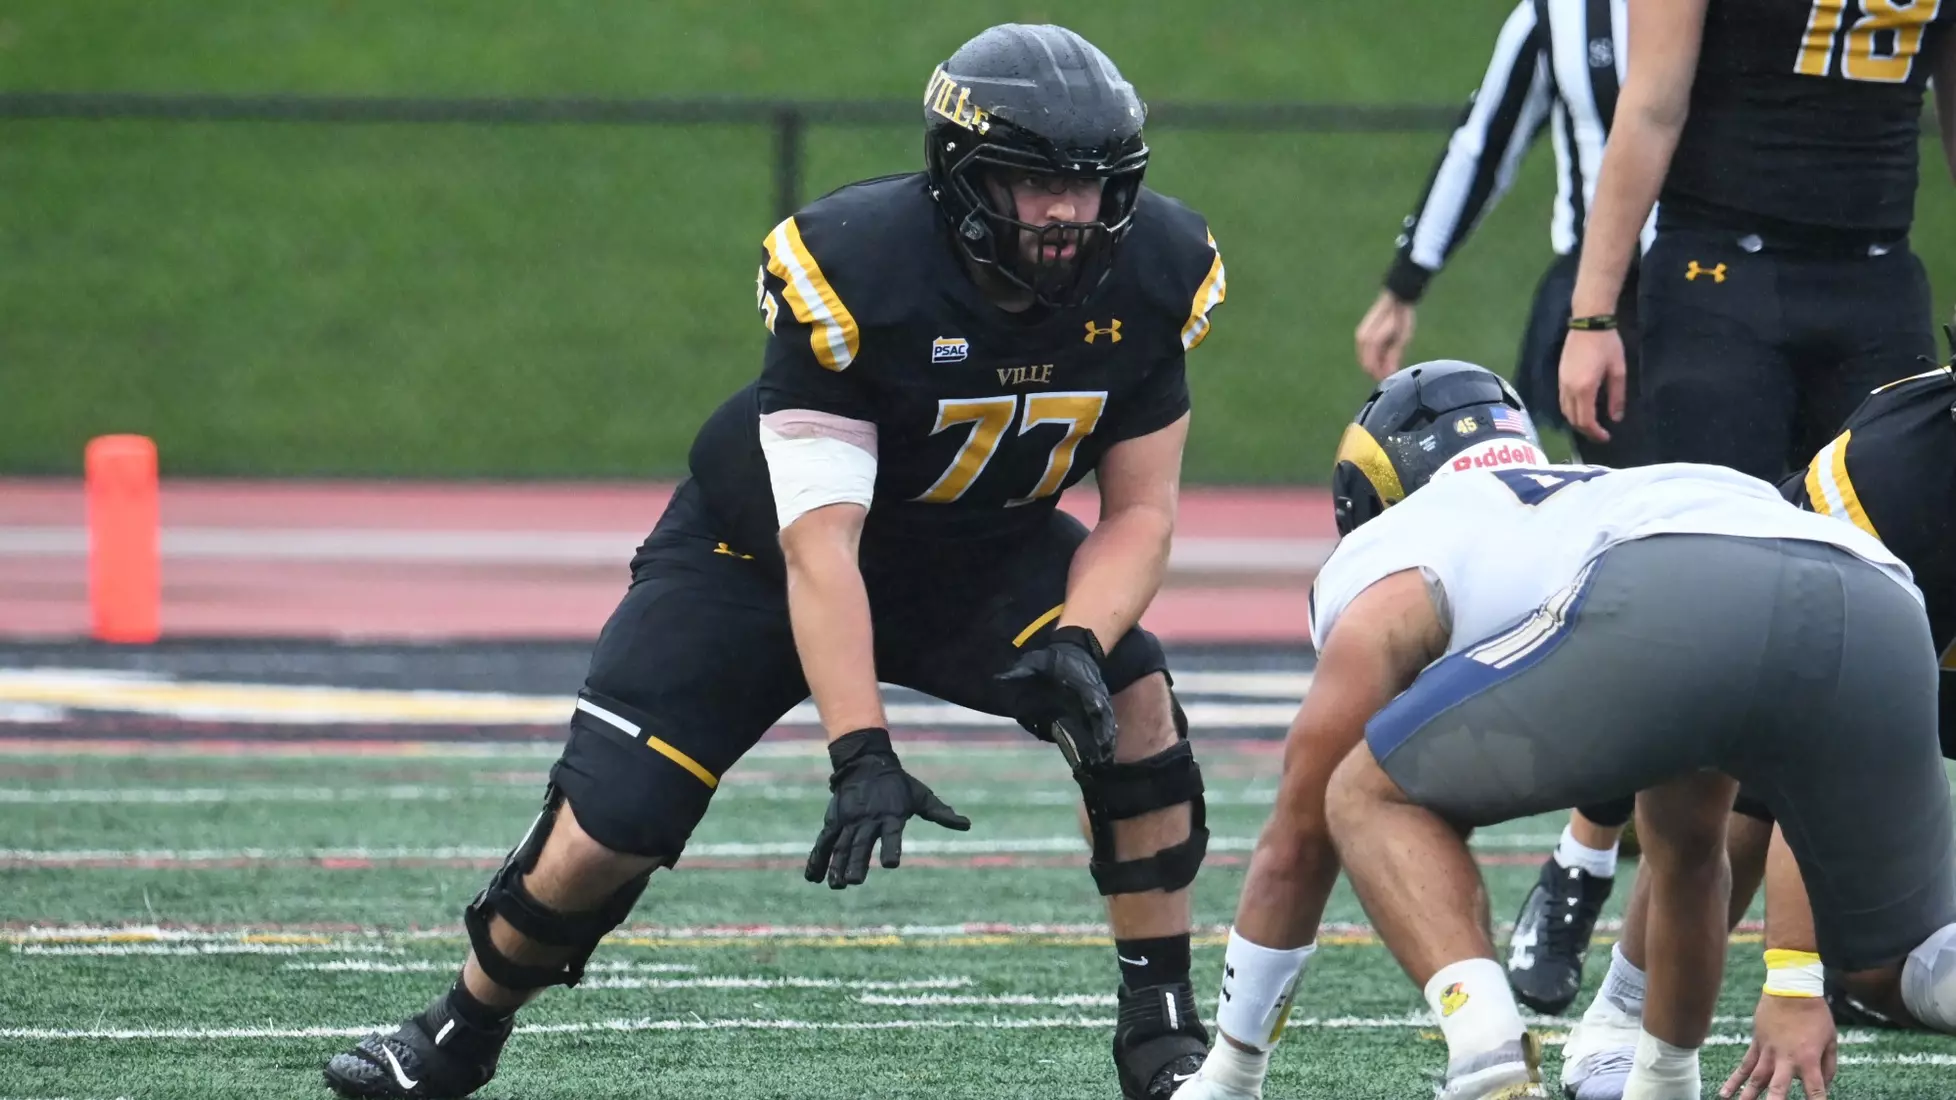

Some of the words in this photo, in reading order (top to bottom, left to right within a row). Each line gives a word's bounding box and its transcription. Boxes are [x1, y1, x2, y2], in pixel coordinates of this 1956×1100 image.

[934, 345, 966, 356] PSAC
[997, 364, 1054, 387] VILLE
[1456, 416, 1478, 434] 45
[906, 391, 1109, 508] 77
[1452, 445, 1537, 472] Riddell
